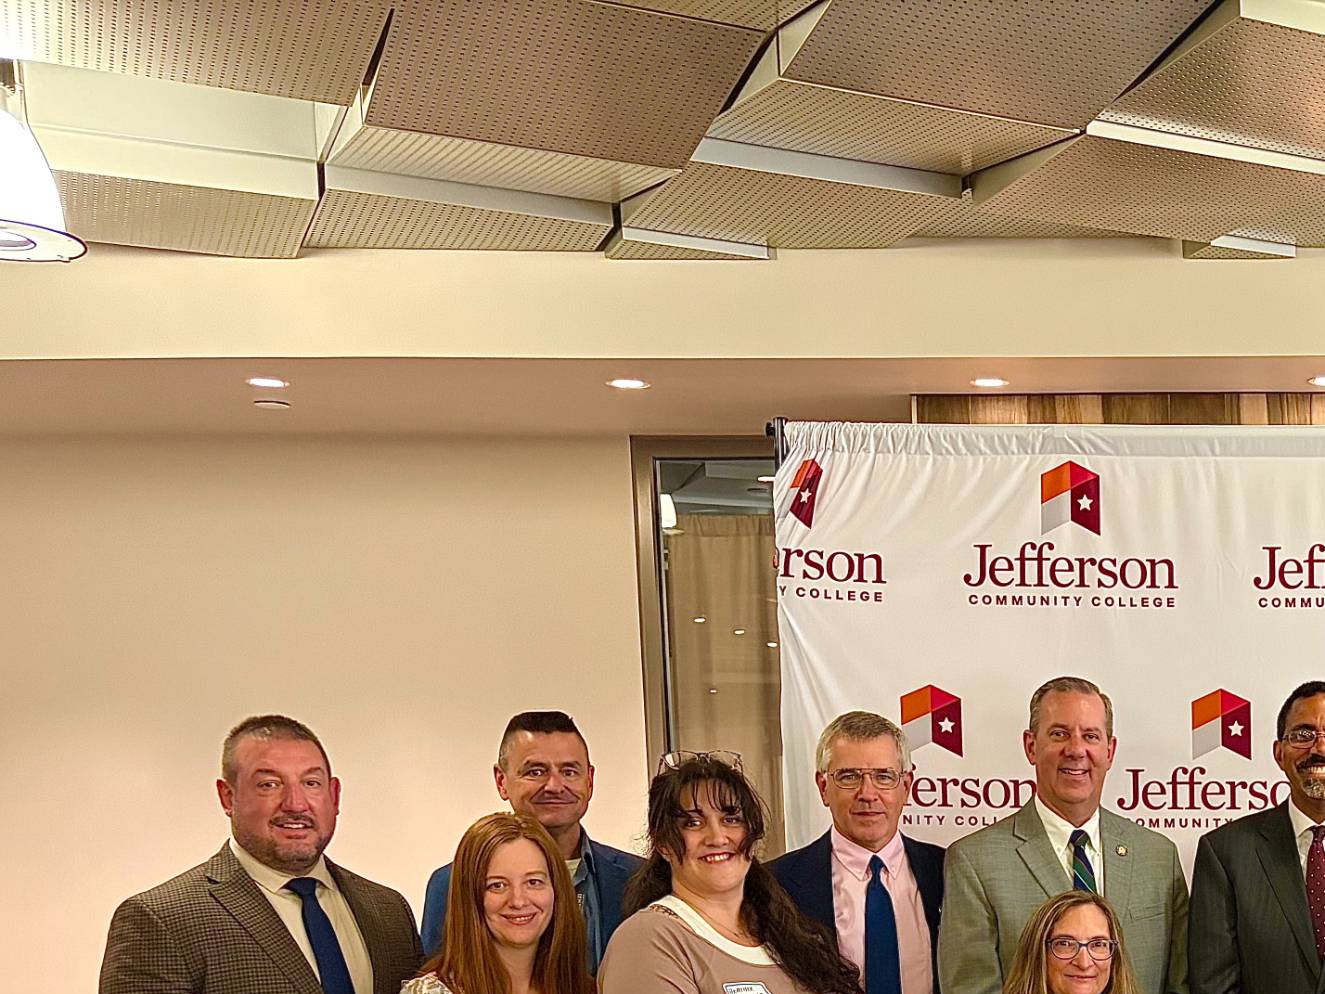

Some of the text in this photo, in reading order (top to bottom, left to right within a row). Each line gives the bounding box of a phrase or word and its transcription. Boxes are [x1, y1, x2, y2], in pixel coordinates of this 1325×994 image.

[963, 541, 1179, 589] Jefferson
[796, 586, 883, 602] COLLEGE
[968, 594, 1175, 607] COMMUNITY COLLEGE
[905, 763, 1037, 809] erson
[1116, 766, 1291, 811] Jefferso
